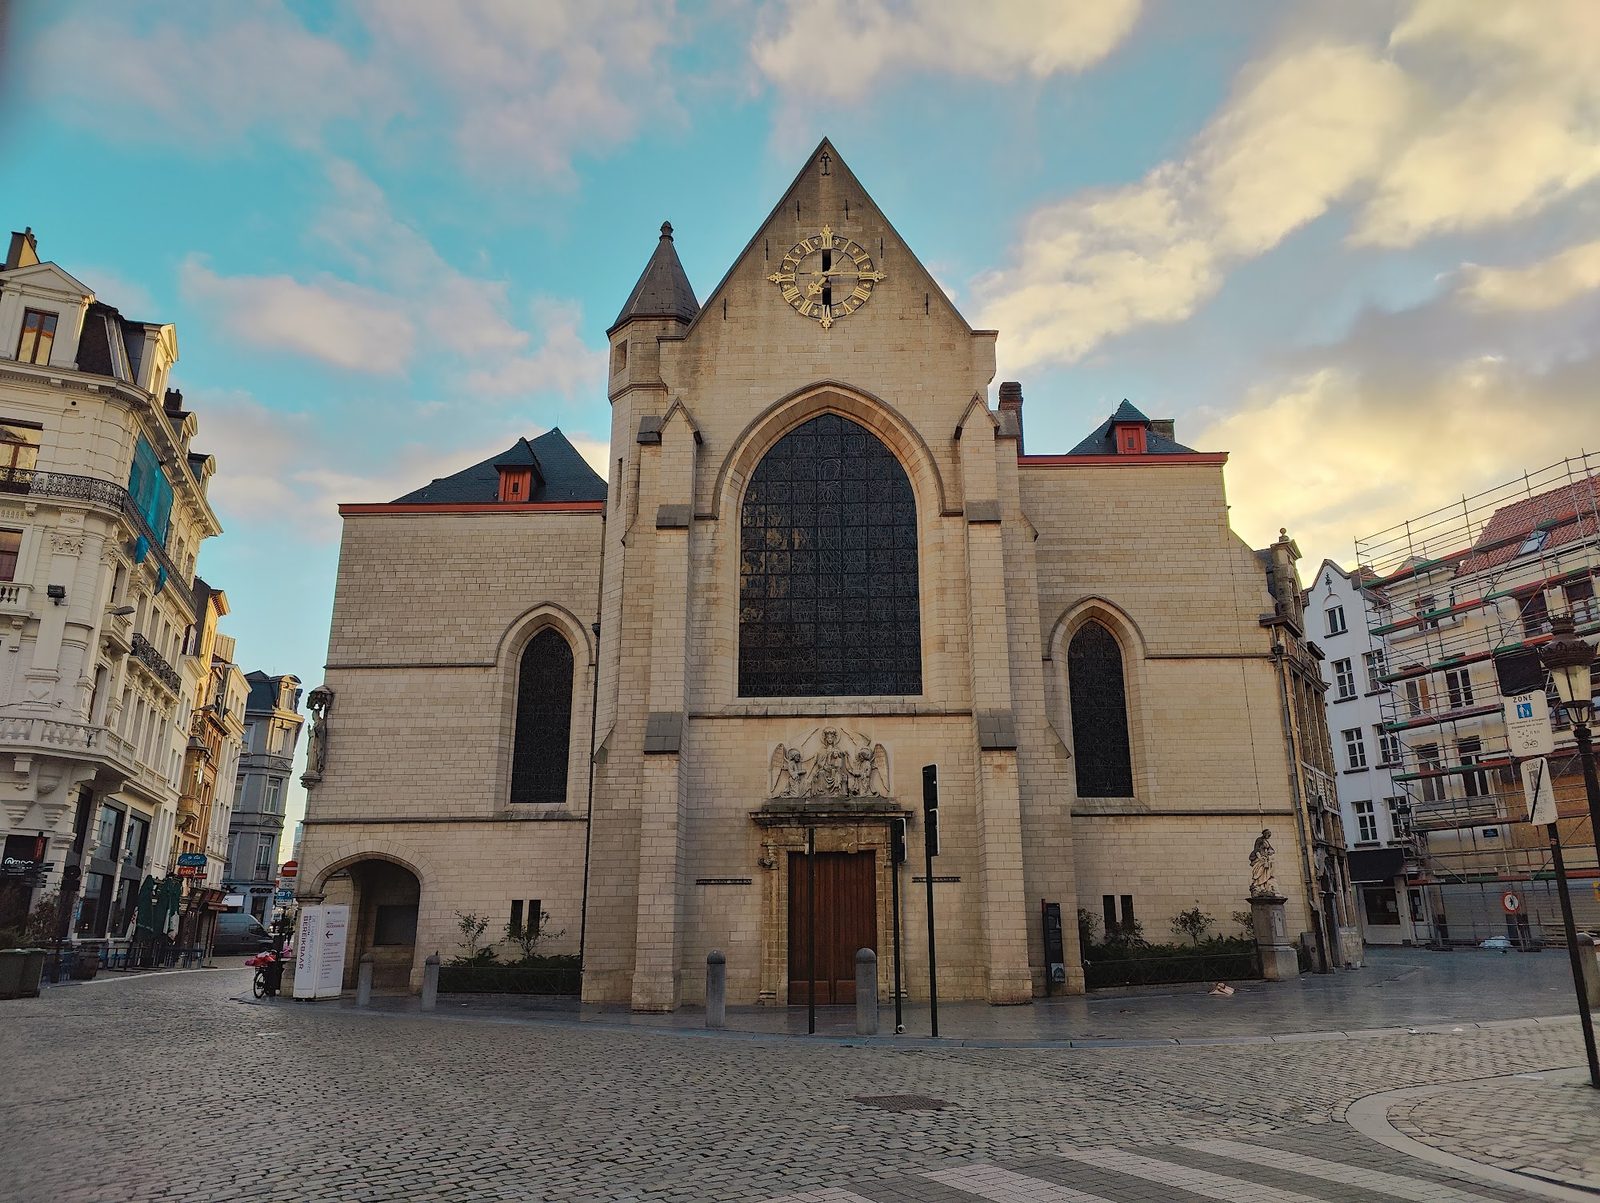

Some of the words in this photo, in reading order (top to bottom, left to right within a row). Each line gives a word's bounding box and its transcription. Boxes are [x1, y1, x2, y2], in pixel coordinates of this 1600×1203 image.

[800, 239, 815, 254] XI
[842, 240, 853, 253] I
[784, 253, 801, 265] X
[853, 253, 870, 264] II
[842, 301, 855, 315] V
[1513, 694, 1533, 703] ZONE
[1526, 762, 1539, 771] ZONE
